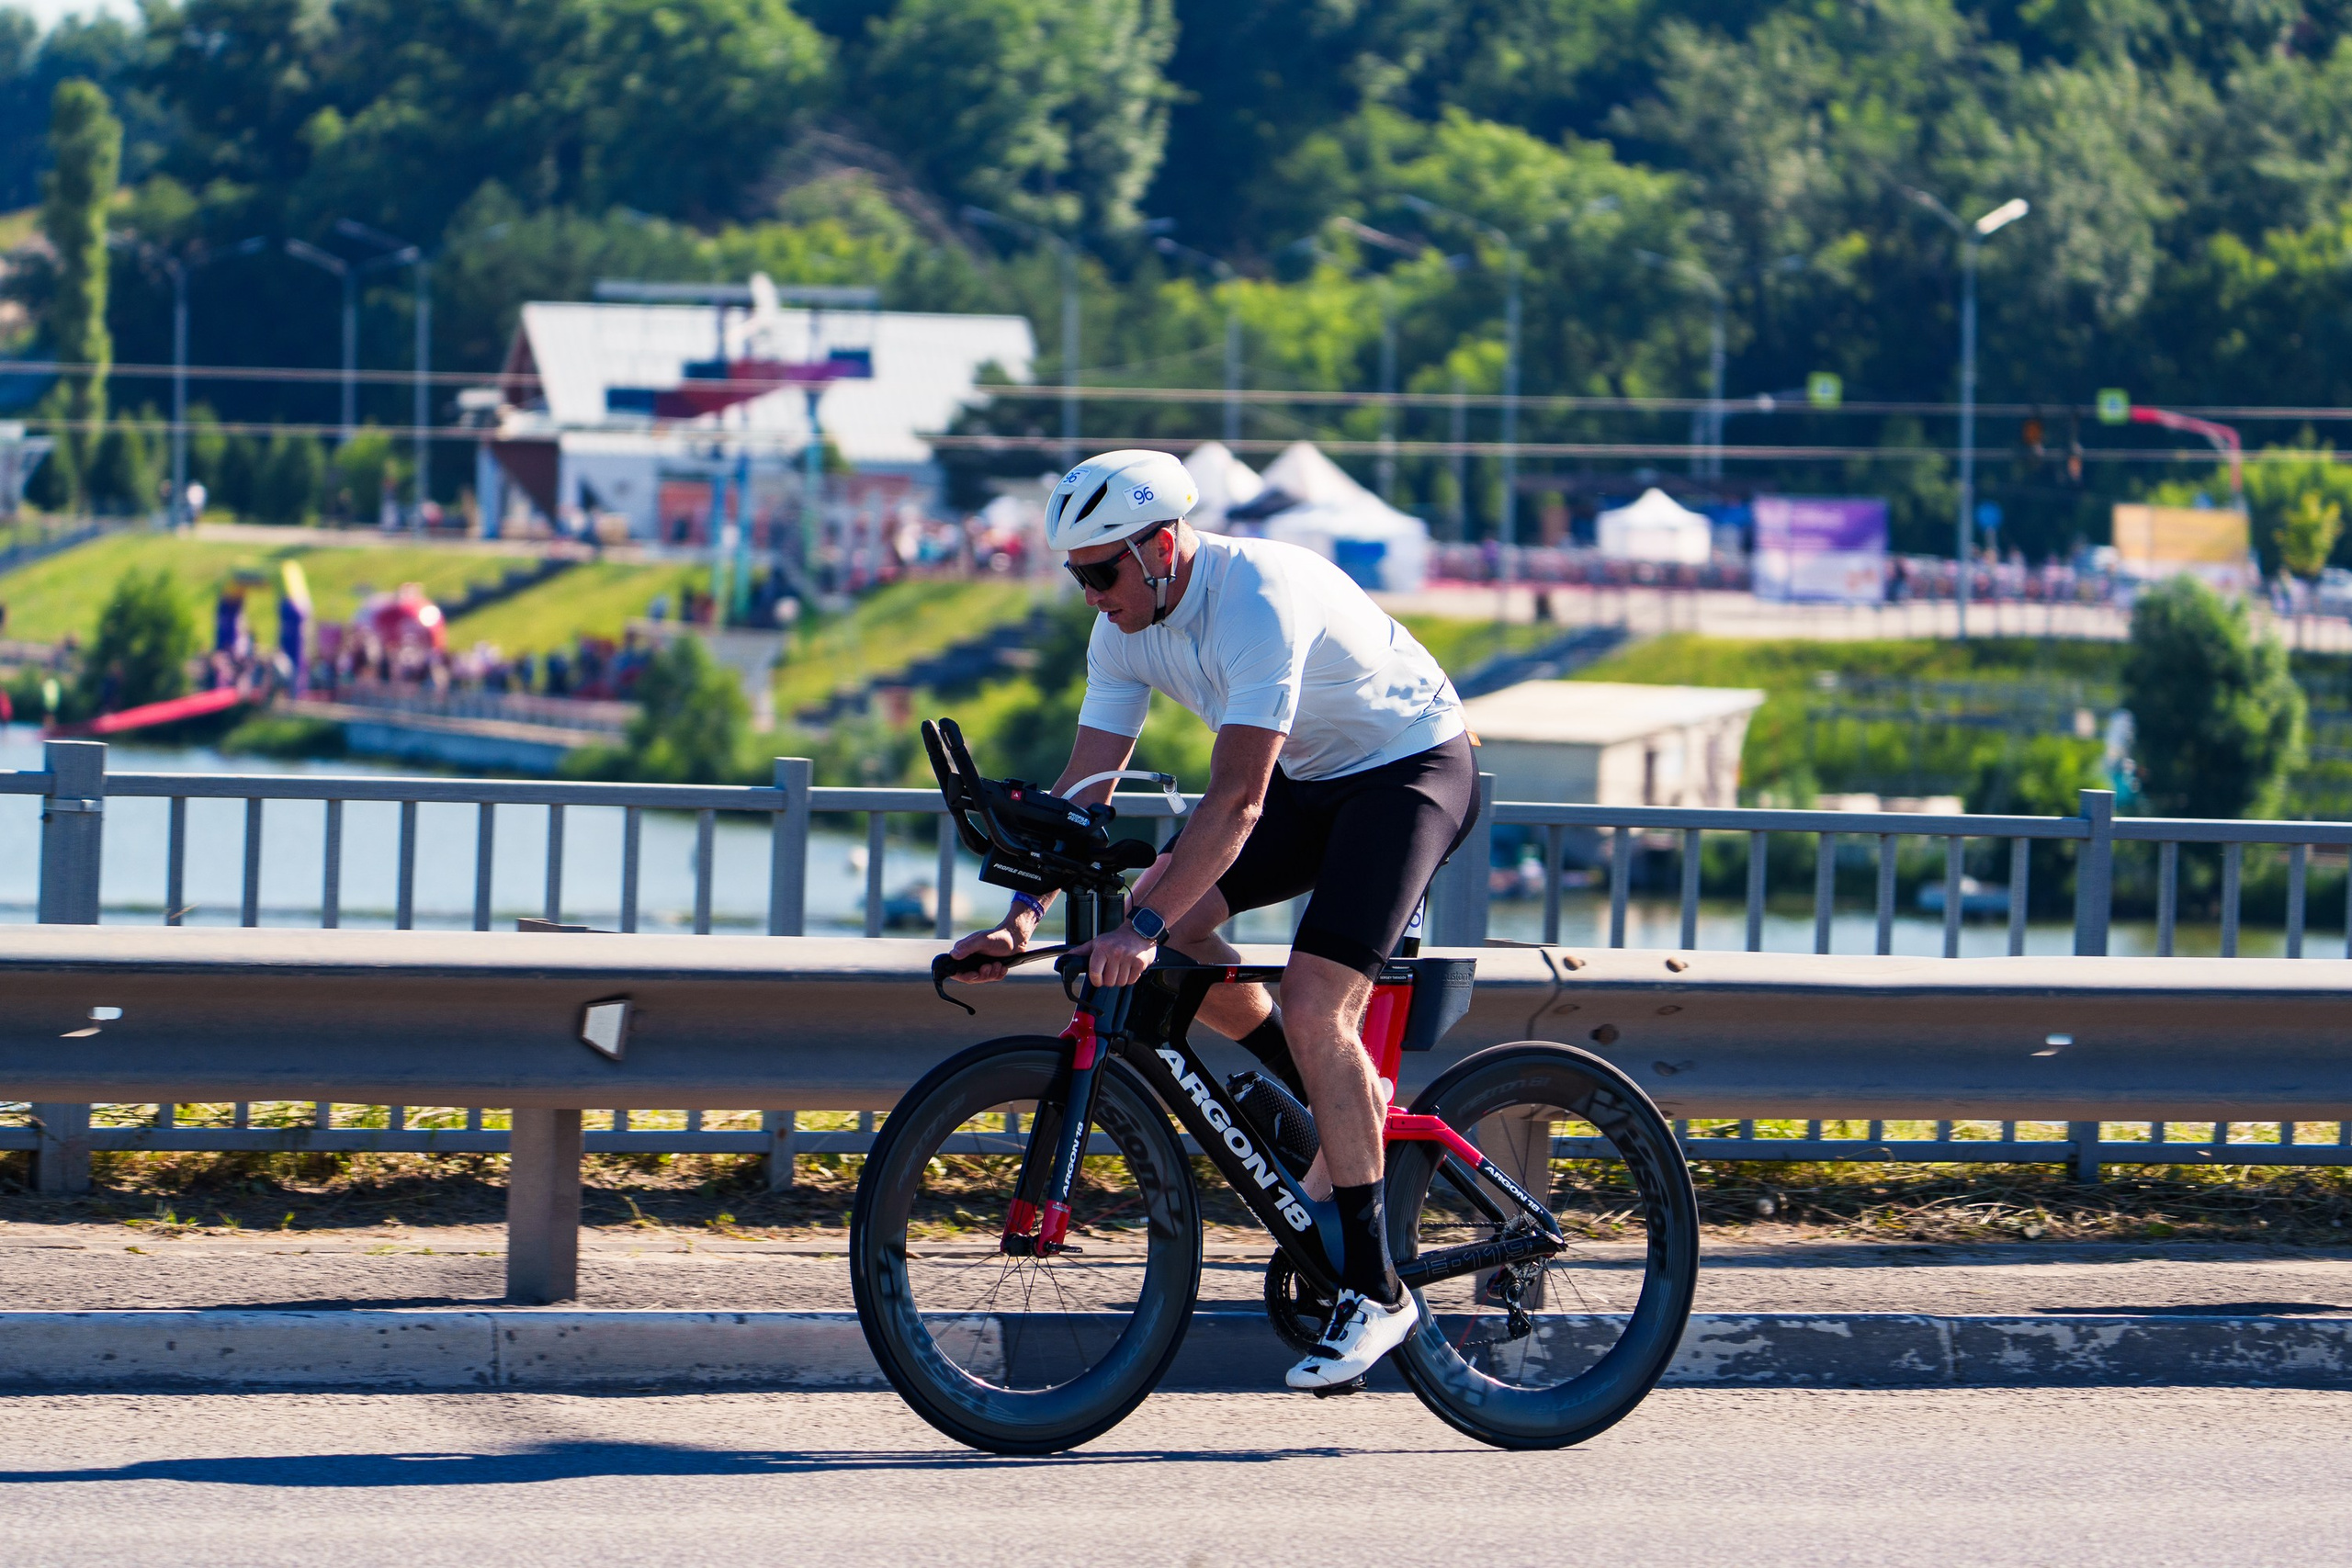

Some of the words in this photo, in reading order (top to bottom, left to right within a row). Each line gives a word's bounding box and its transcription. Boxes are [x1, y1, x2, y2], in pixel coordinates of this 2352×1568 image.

[1063, 472, 1080, 483] 96
[1134, 486, 1154, 505] 96
[1067, 811, 1089, 823] PROFILE
[993, 863, 1019, 874] PROFILE
[1017, 869, 1040, 880] DESIGN
[1156, 1048, 1279, 1190] ARGON
[1273, 1186, 1313, 1233] 18
[1062, 1138, 1080, 1199] ARGON
[1075, 1121, 1084, 1138] 18
[1484, 1166, 1528, 1202] ARGON
[1527, 1200, 1541, 1213] 18
[1424, 1240, 1530, 1278] E-119
